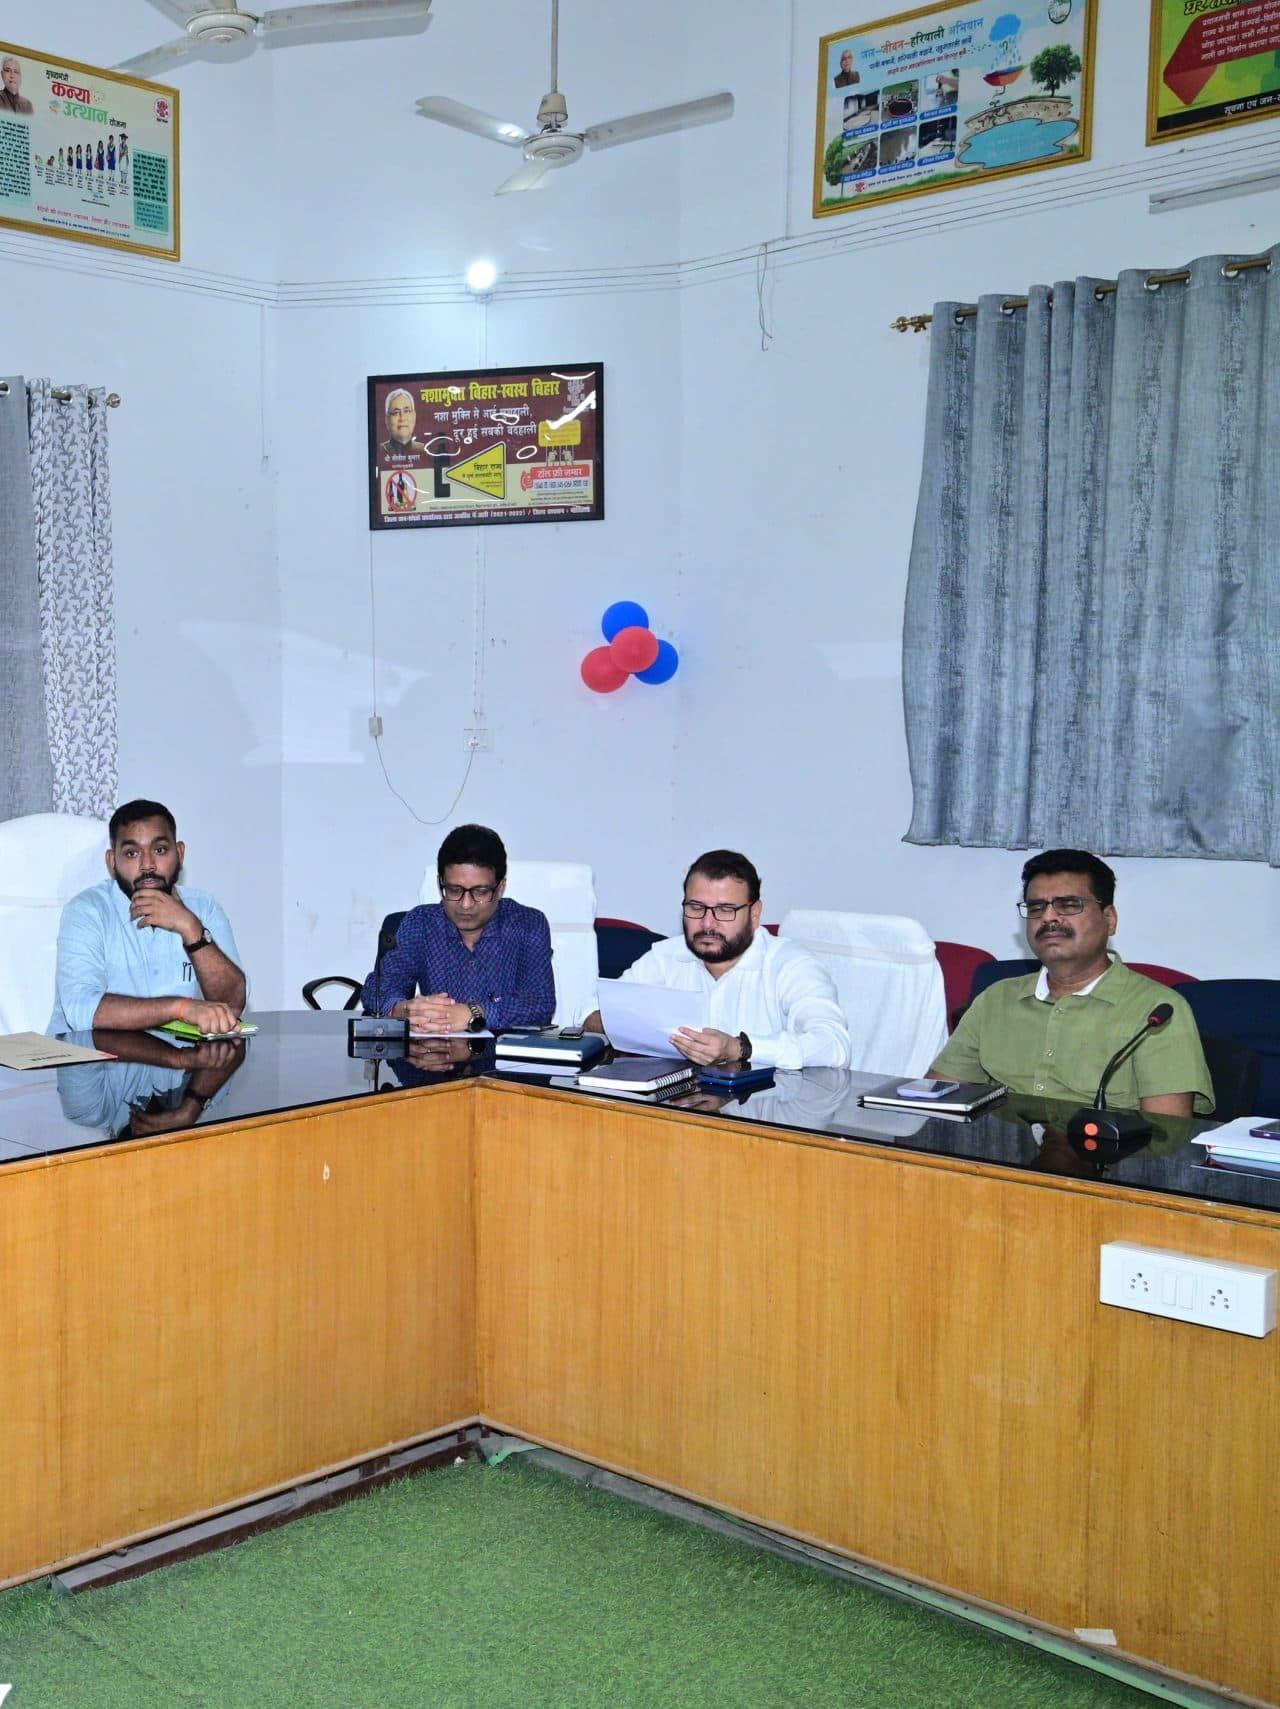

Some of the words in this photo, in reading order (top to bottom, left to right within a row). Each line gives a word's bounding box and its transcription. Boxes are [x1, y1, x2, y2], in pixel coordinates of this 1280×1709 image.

[949, 17, 984, 35] अभियान
[45, 69, 69, 81] मुख्यमंत्री
[51, 81, 90, 104] कन्या
[63, 100, 109, 125] उत्थान
[109, 118, 127, 129] योजना
[531, 378, 560, 397] बिहार
[434, 411, 449, 423] नशा
[451, 407, 471, 425] मुक्ति
[473, 408, 480, 420] से
[453, 428, 463, 442] दूर
[481, 423, 504, 437] सबकी
[506, 421, 537, 436] बदहाली
